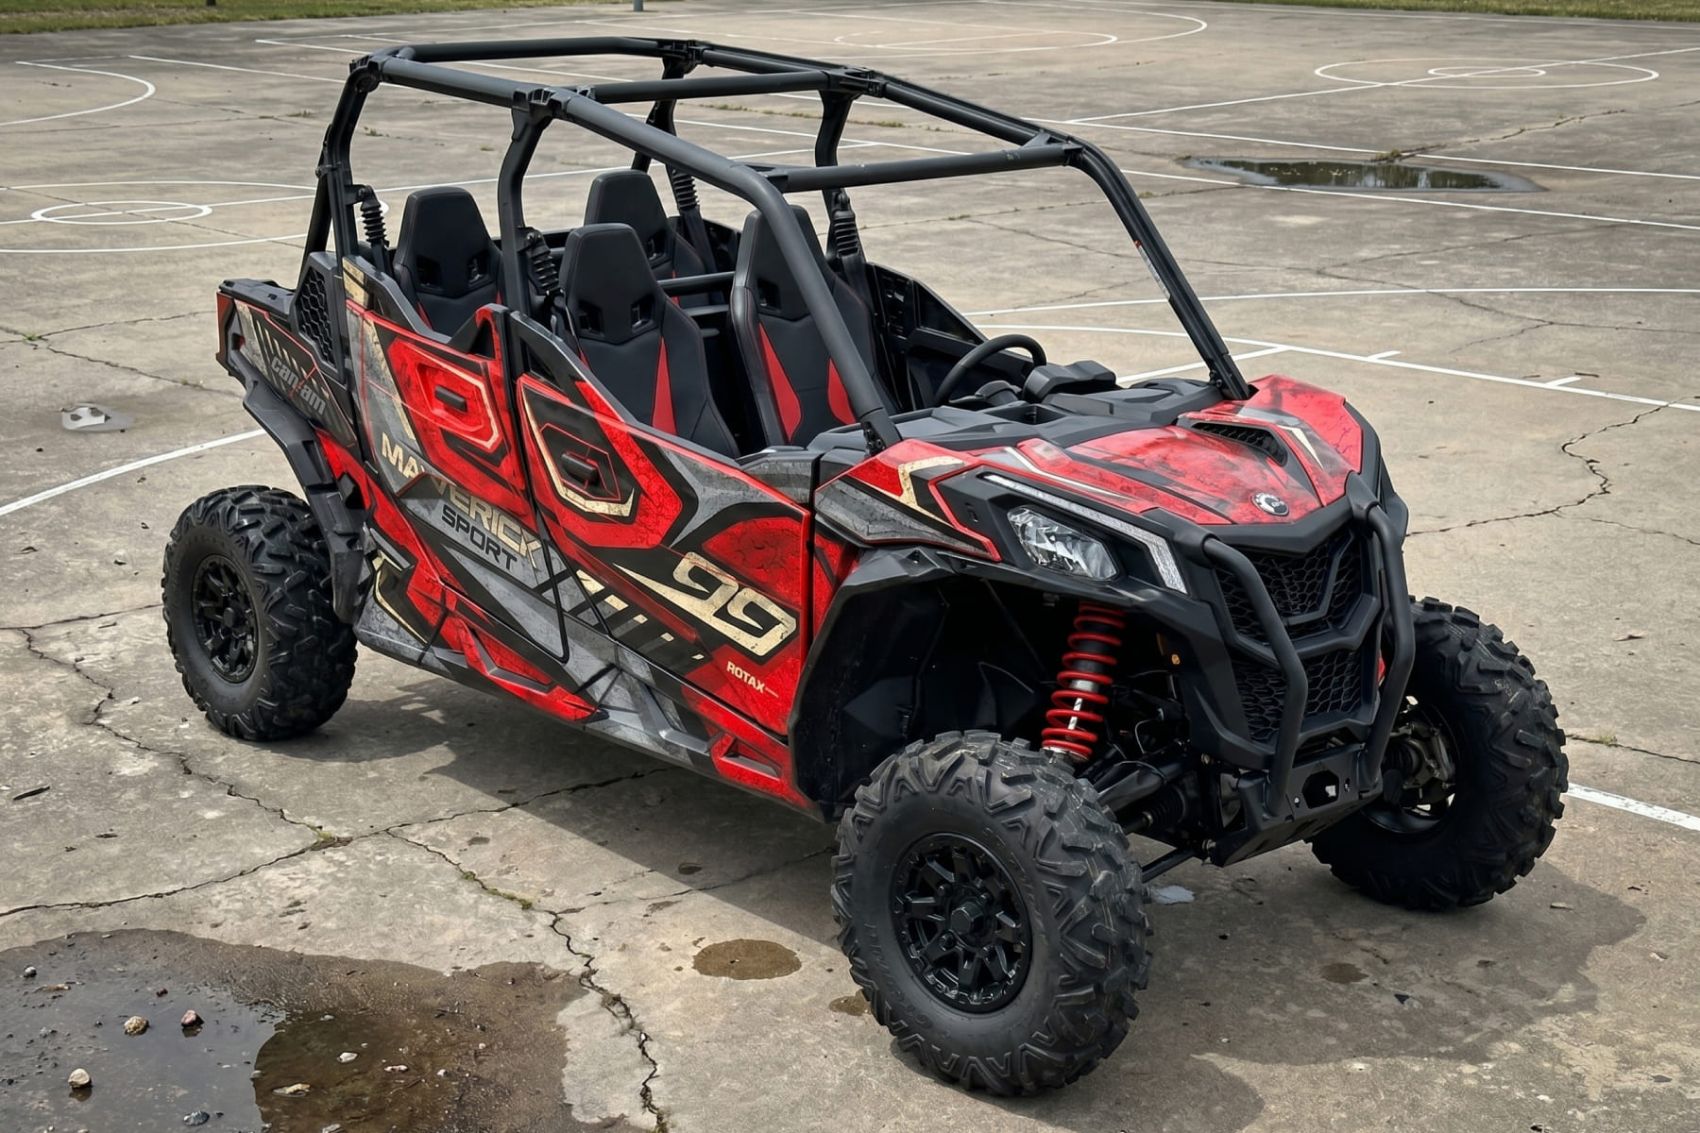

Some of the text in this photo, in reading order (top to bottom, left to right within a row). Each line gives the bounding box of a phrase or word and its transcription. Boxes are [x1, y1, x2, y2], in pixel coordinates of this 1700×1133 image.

[441, 504, 518, 571] SPORT
[613, 551, 797, 657] 99
[725, 660, 766, 695] ROTAX
